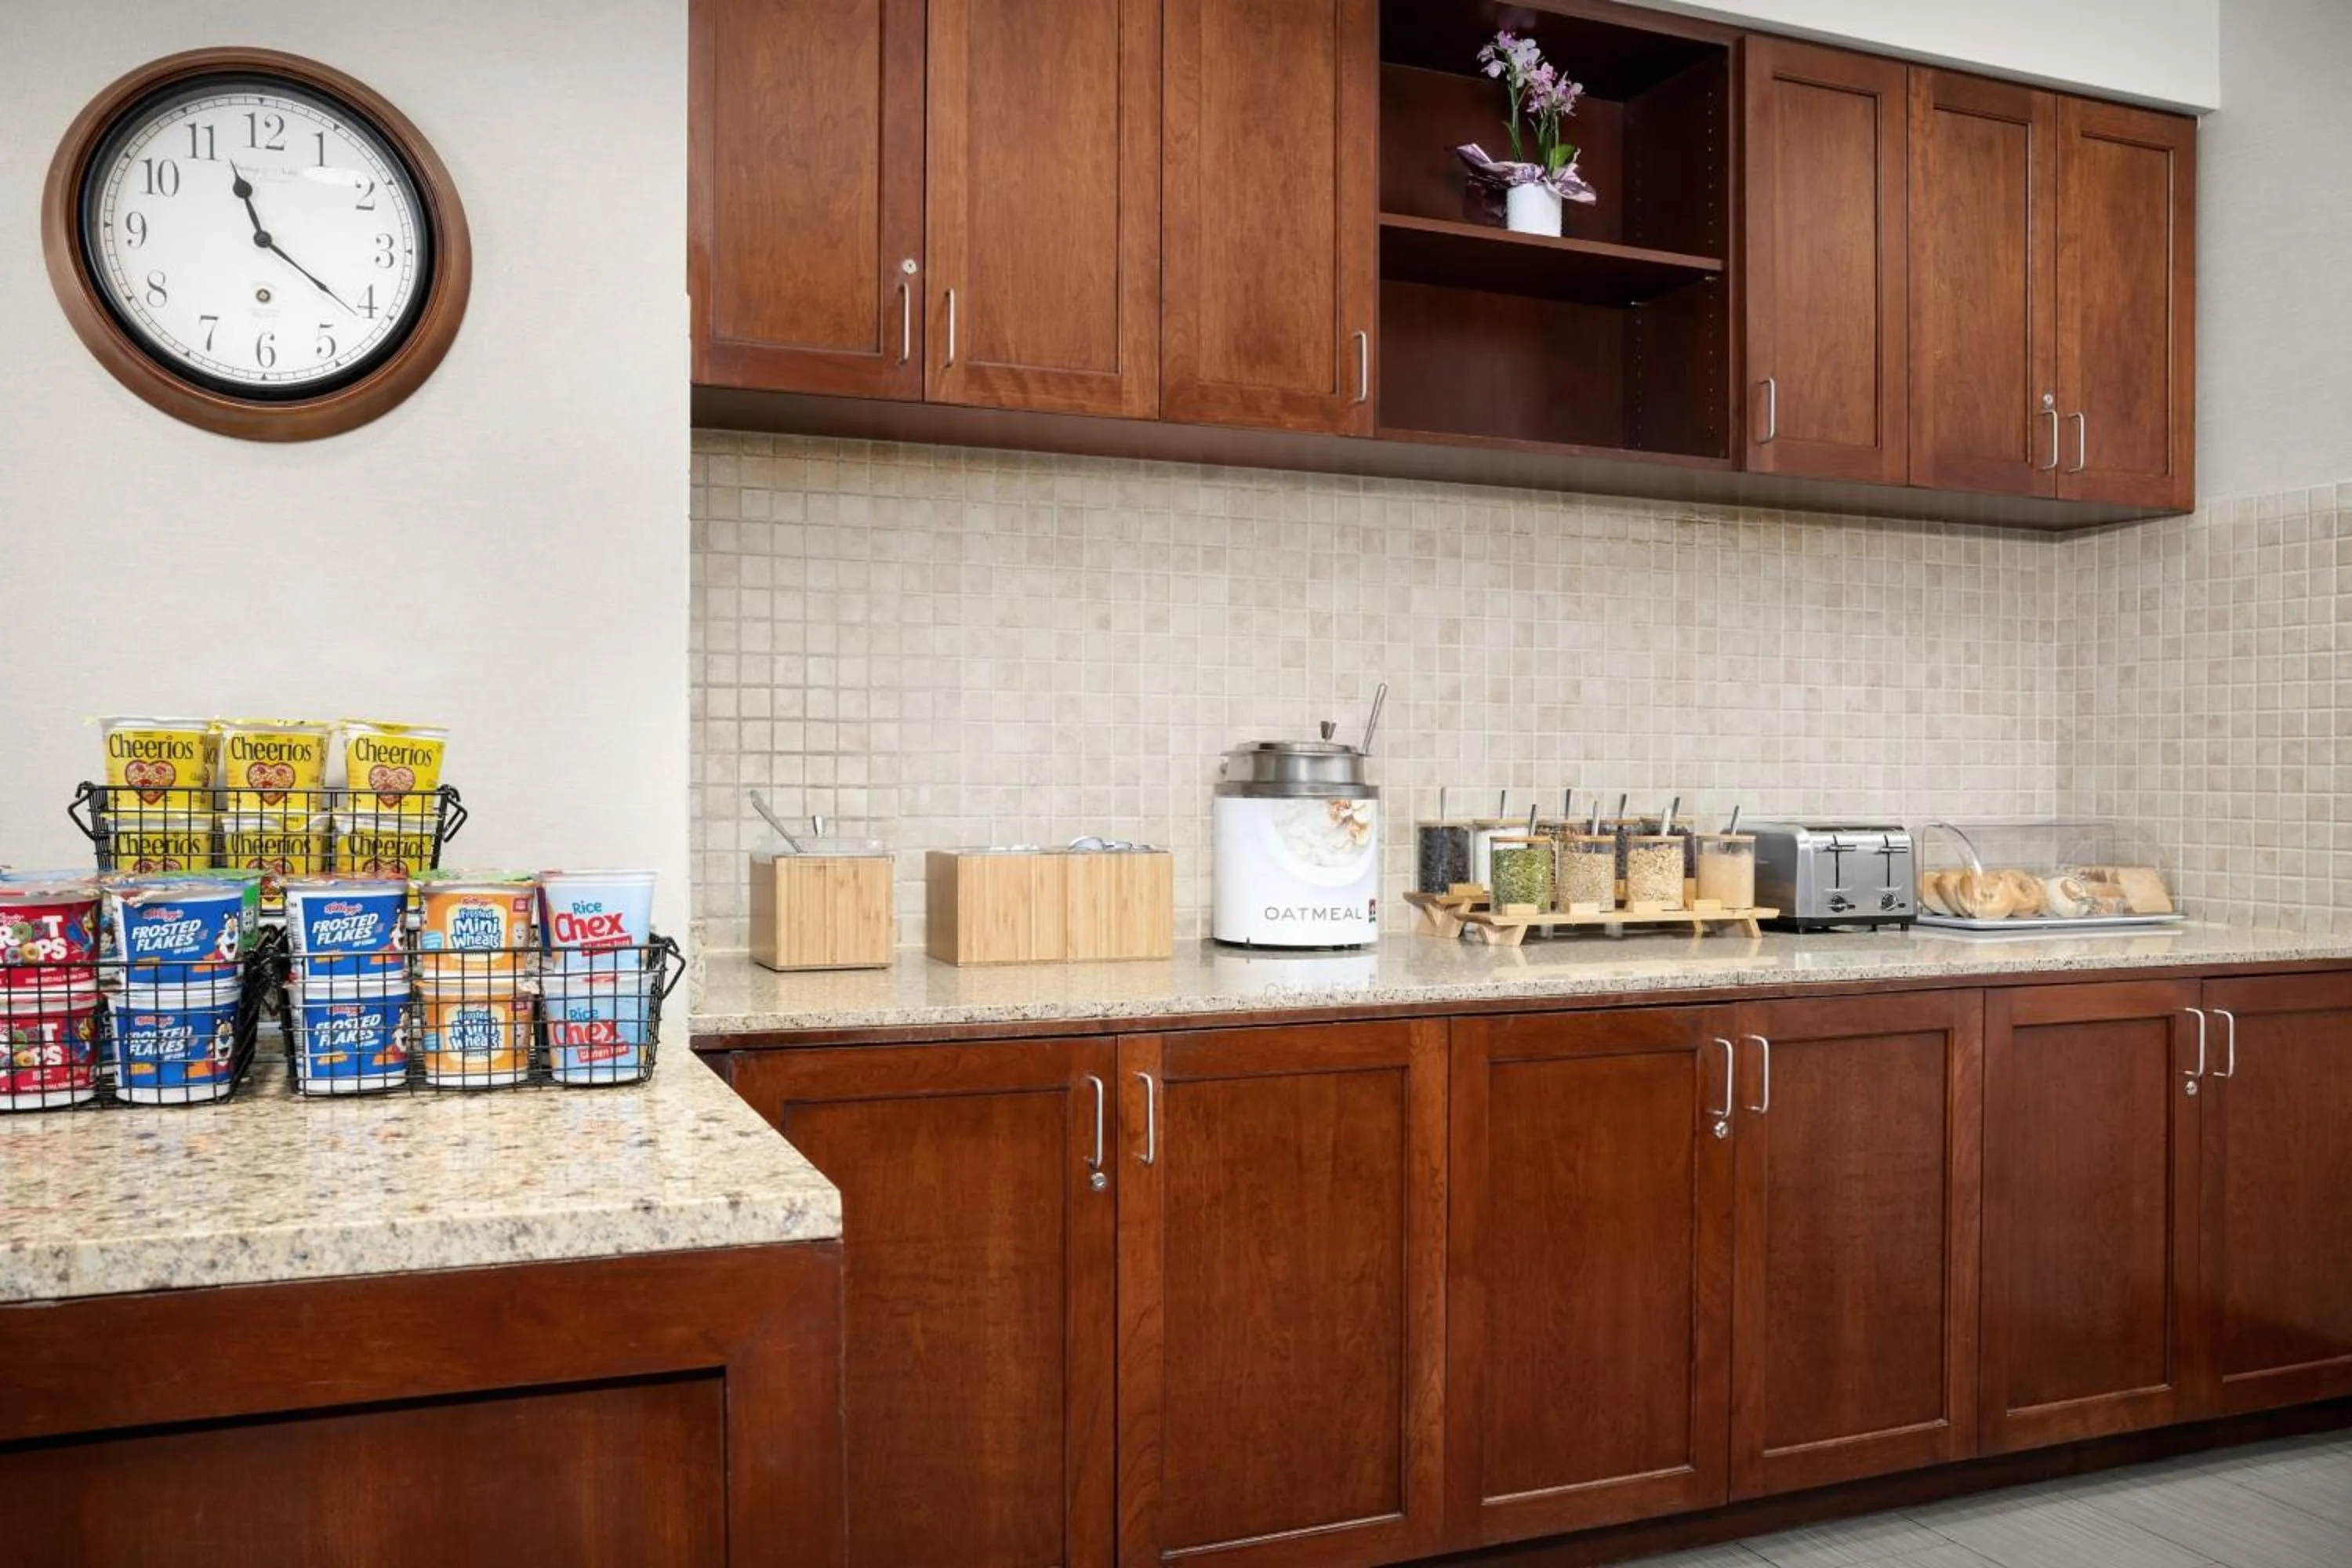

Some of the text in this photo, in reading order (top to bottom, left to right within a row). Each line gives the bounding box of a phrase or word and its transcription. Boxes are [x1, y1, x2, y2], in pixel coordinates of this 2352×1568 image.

[183, 122, 222, 163] 11
[242, 111, 286, 151] 12
[311, 131, 328, 168] 1
[140, 158, 180, 198] 10
[355, 177, 376, 212] 2
[125, 211, 147, 249] 9
[375, 233, 394, 269] 3
[147, 269, 168, 308] 8
[357, 283, 379, 320] 4
[199, 314, 219, 353] 7
[316, 323, 336, 359] 5
[256, 330, 276, 368] 6
[109, 733, 194, 760] Cheerios
[230, 736, 311, 762] Cheerios
[355, 738, 433, 768] Cheerios
[116, 832, 201, 856] Cheerios
[230, 832, 311, 855] Cheerios
[348, 833, 426, 858] Cheerios
[572, 901, 602, 915] Rice
[1265, 906, 1362, 920] OATMEAL
[132, 919, 201, 940] FROSTED
[312, 913, 379, 934] FROSTED
[316, 925, 373, 946] FLAKES
[455, 918, 499, 935] Mini
[554, 913, 627, 943] Chex
[136, 932, 195, 953] FLAKES
[452, 932, 500, 949] Wheats
[569, 1007, 600, 1022] Rice
[450, 1033, 500, 1049] Wheas
